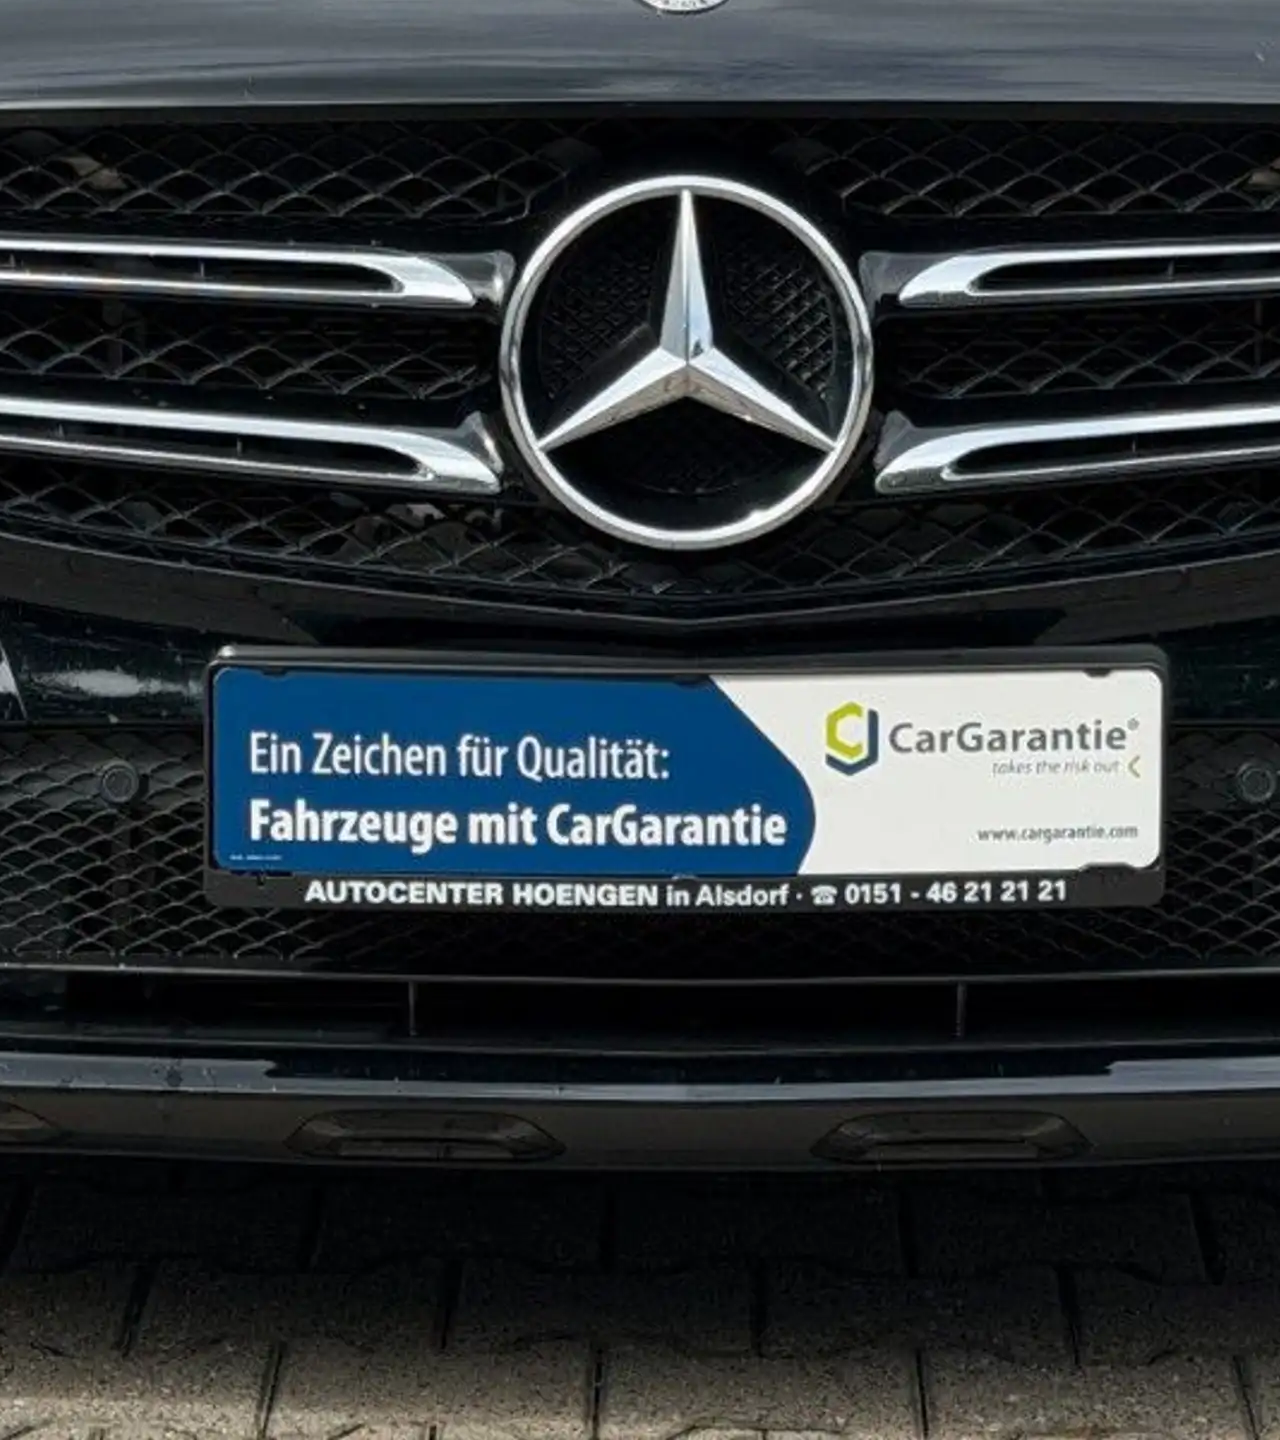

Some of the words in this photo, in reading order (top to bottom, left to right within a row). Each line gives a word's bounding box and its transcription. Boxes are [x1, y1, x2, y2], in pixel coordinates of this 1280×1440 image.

[250, 731, 302, 774] Ein
[311, 732, 447, 777] Zeichen
[456, 733, 509, 777] für
[516, 735, 669, 782] Qualität:
[1036, 759, 1061, 774] the
[1064, 759, 1090, 773] risk
[1094, 760, 1119, 773] out
[250, 798, 458, 854] Fahrzeuge
[468, 802, 538, 846] mit
[547, 803, 787, 846] CarGarantie
[977, 825, 1139, 844] www.cargarantie.com
[304, 879, 504, 906] AUTOCENTER
[512, 882, 659, 907] HOENGEN
[666, 884, 689, 906] in
[695, 878, 790, 907] Alsdorf
[844, 882, 901, 905] 0151
[925, 881, 958, 903] 46
[963, 880, 992, 903] 21
[1000, 880, 1029, 902] 21
[1037, 879, 1066, 902] 21
